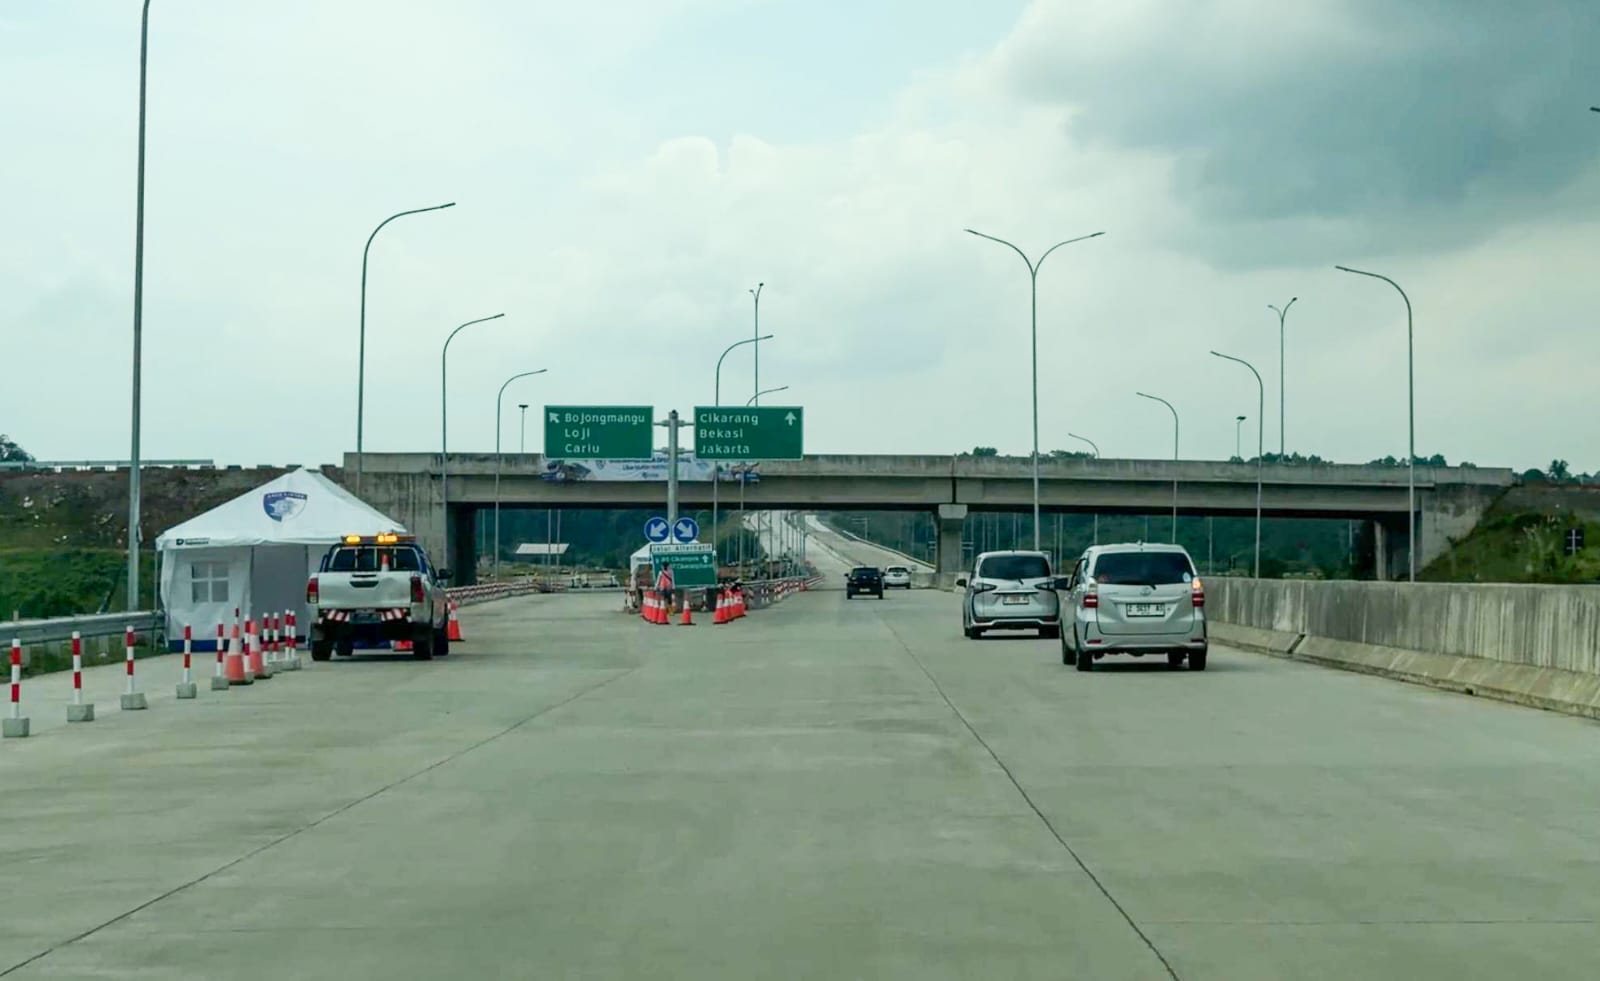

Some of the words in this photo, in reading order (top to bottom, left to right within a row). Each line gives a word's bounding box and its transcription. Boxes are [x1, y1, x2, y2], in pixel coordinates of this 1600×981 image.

[564, 412, 645, 425] Bojongmangu
[699, 413, 759, 426] Cikarang
[564, 427, 590, 440] Loji
[699, 428, 744, 439] Bekasi
[564, 443, 600, 454] Cariu
[699, 444, 750, 454] Jakarta
